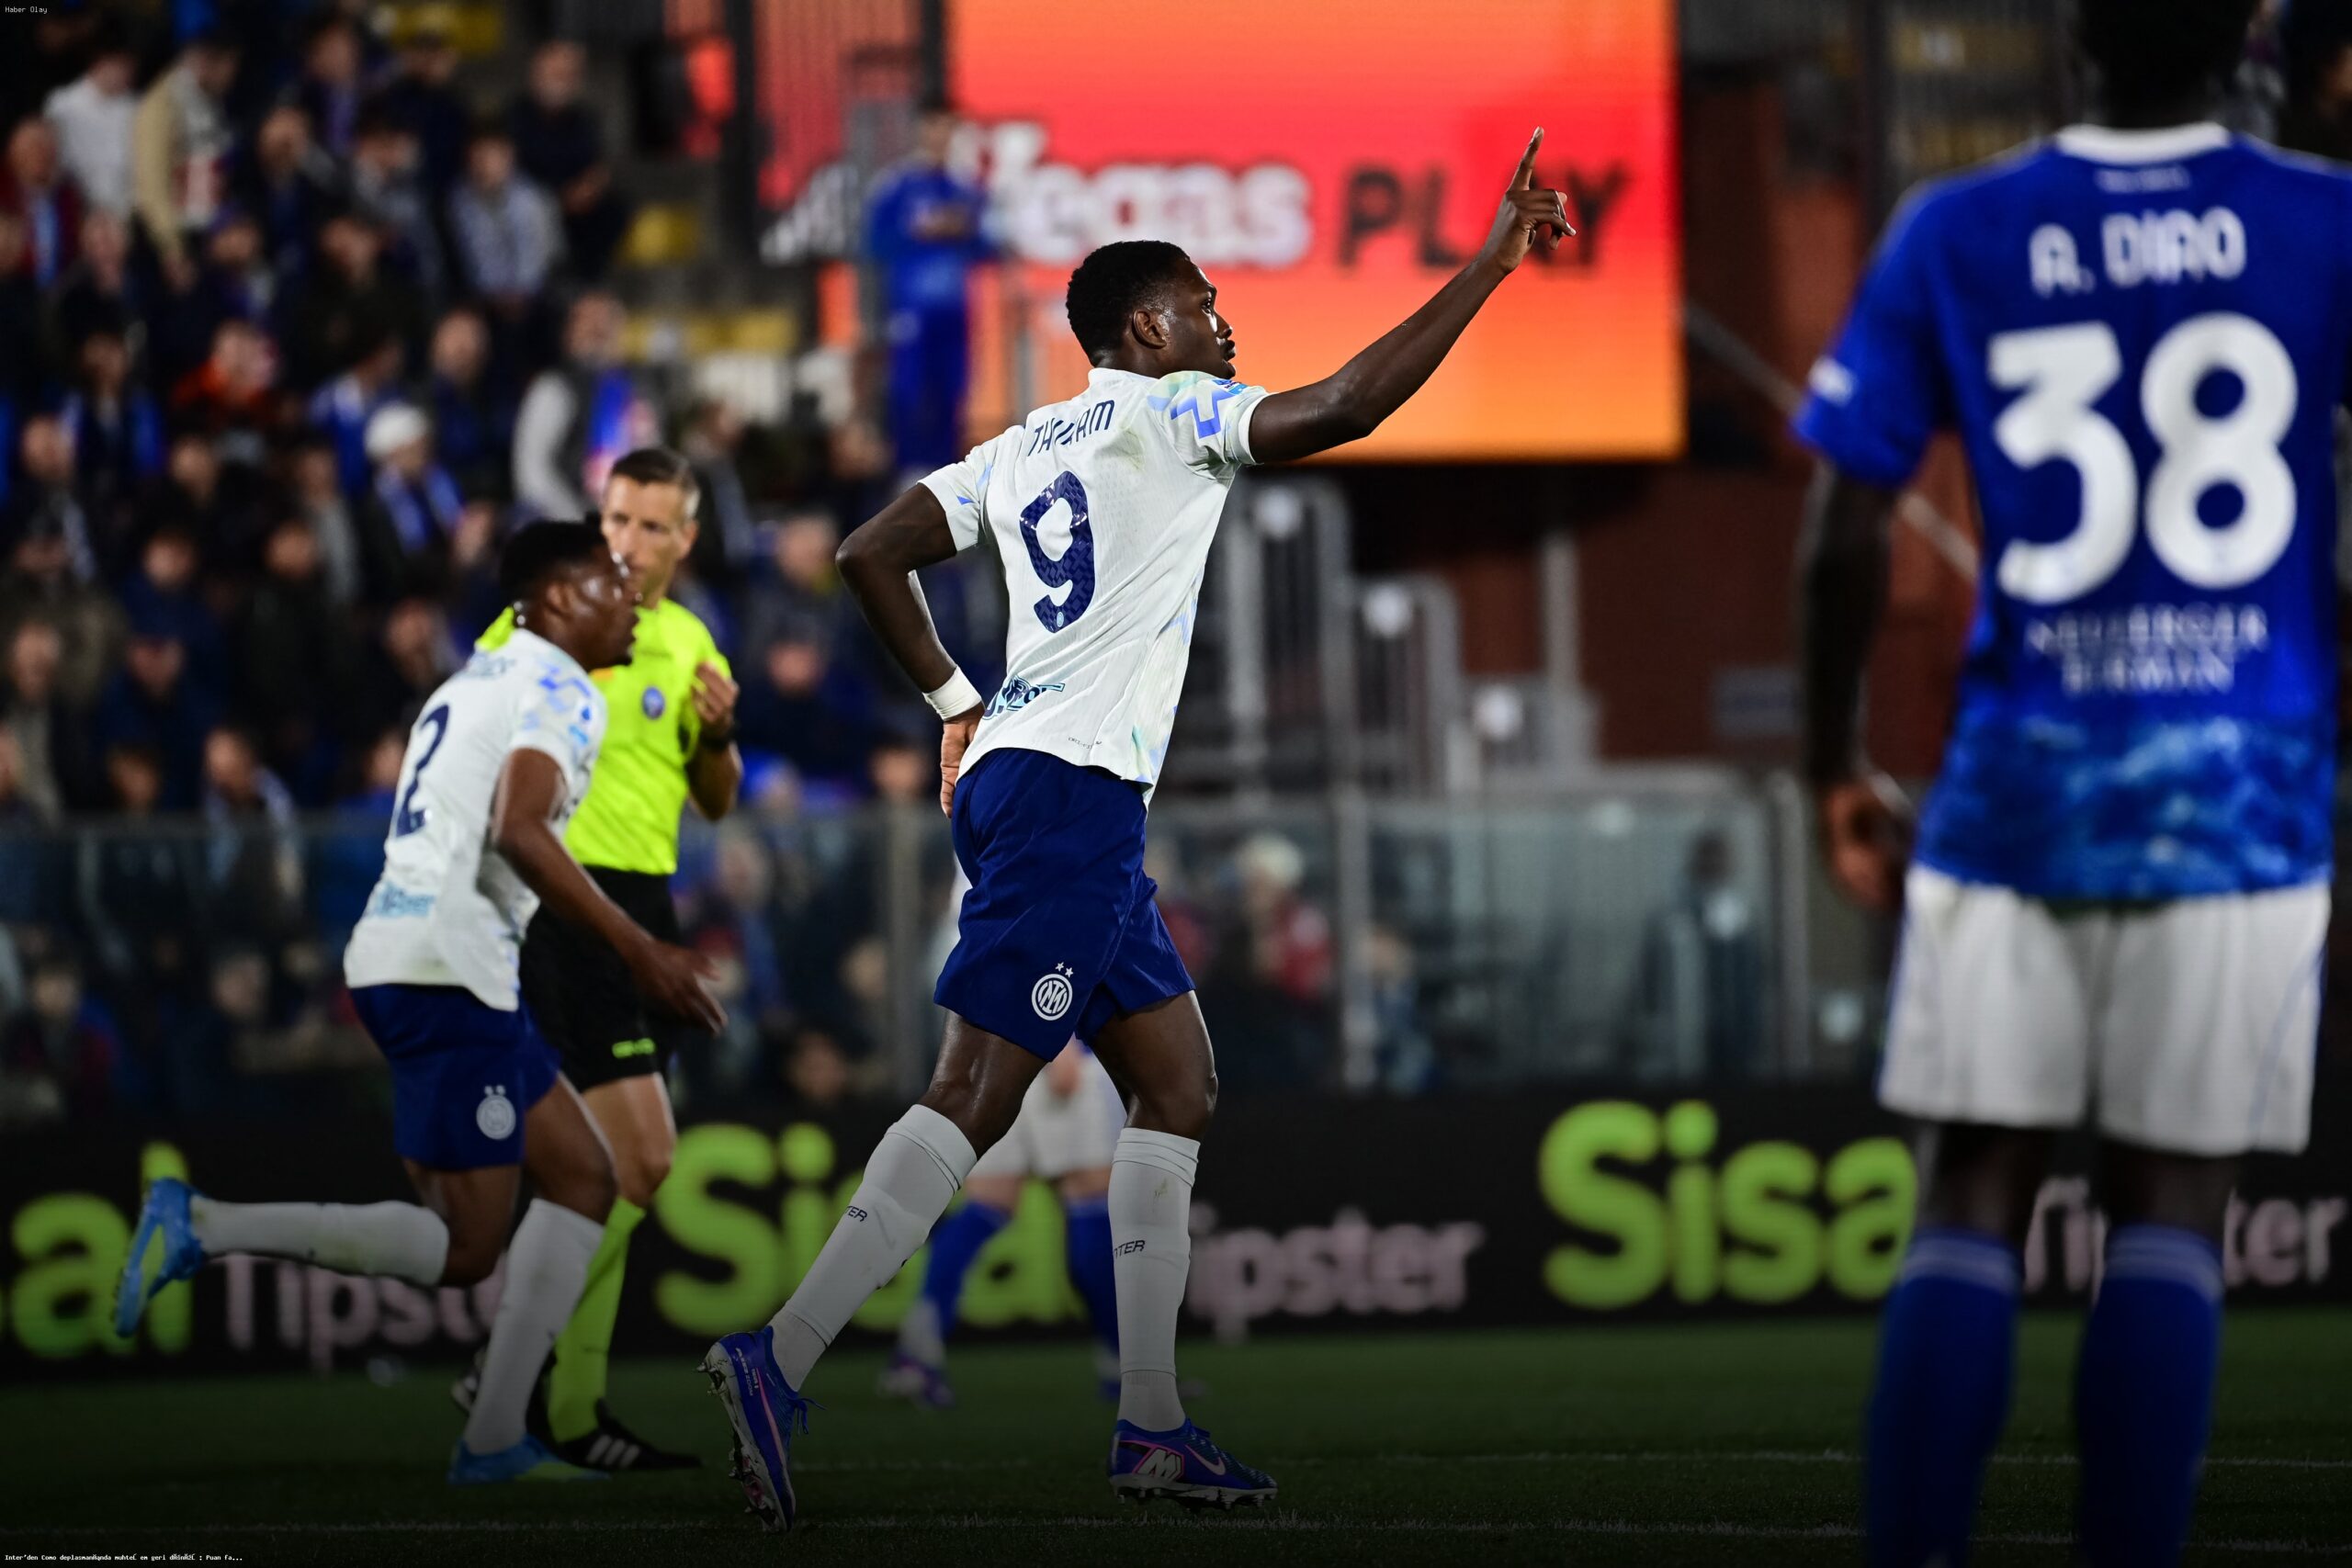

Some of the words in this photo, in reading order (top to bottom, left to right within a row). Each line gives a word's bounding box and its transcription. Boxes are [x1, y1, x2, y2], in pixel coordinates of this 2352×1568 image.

[1027, 399, 1115, 457] THAM
[1986, 311, 2298, 605] 38
[1019, 471, 1097, 634] 9
[395, 704, 449, 838] 2
[0, 1139, 193, 1359] al
[844, 1205, 868, 1223] TER
[1114, 1239, 1146, 1259] TER
[1186, 1203, 1488, 1344] ipster
[1537, 1099, 1918, 1311] Sisa
